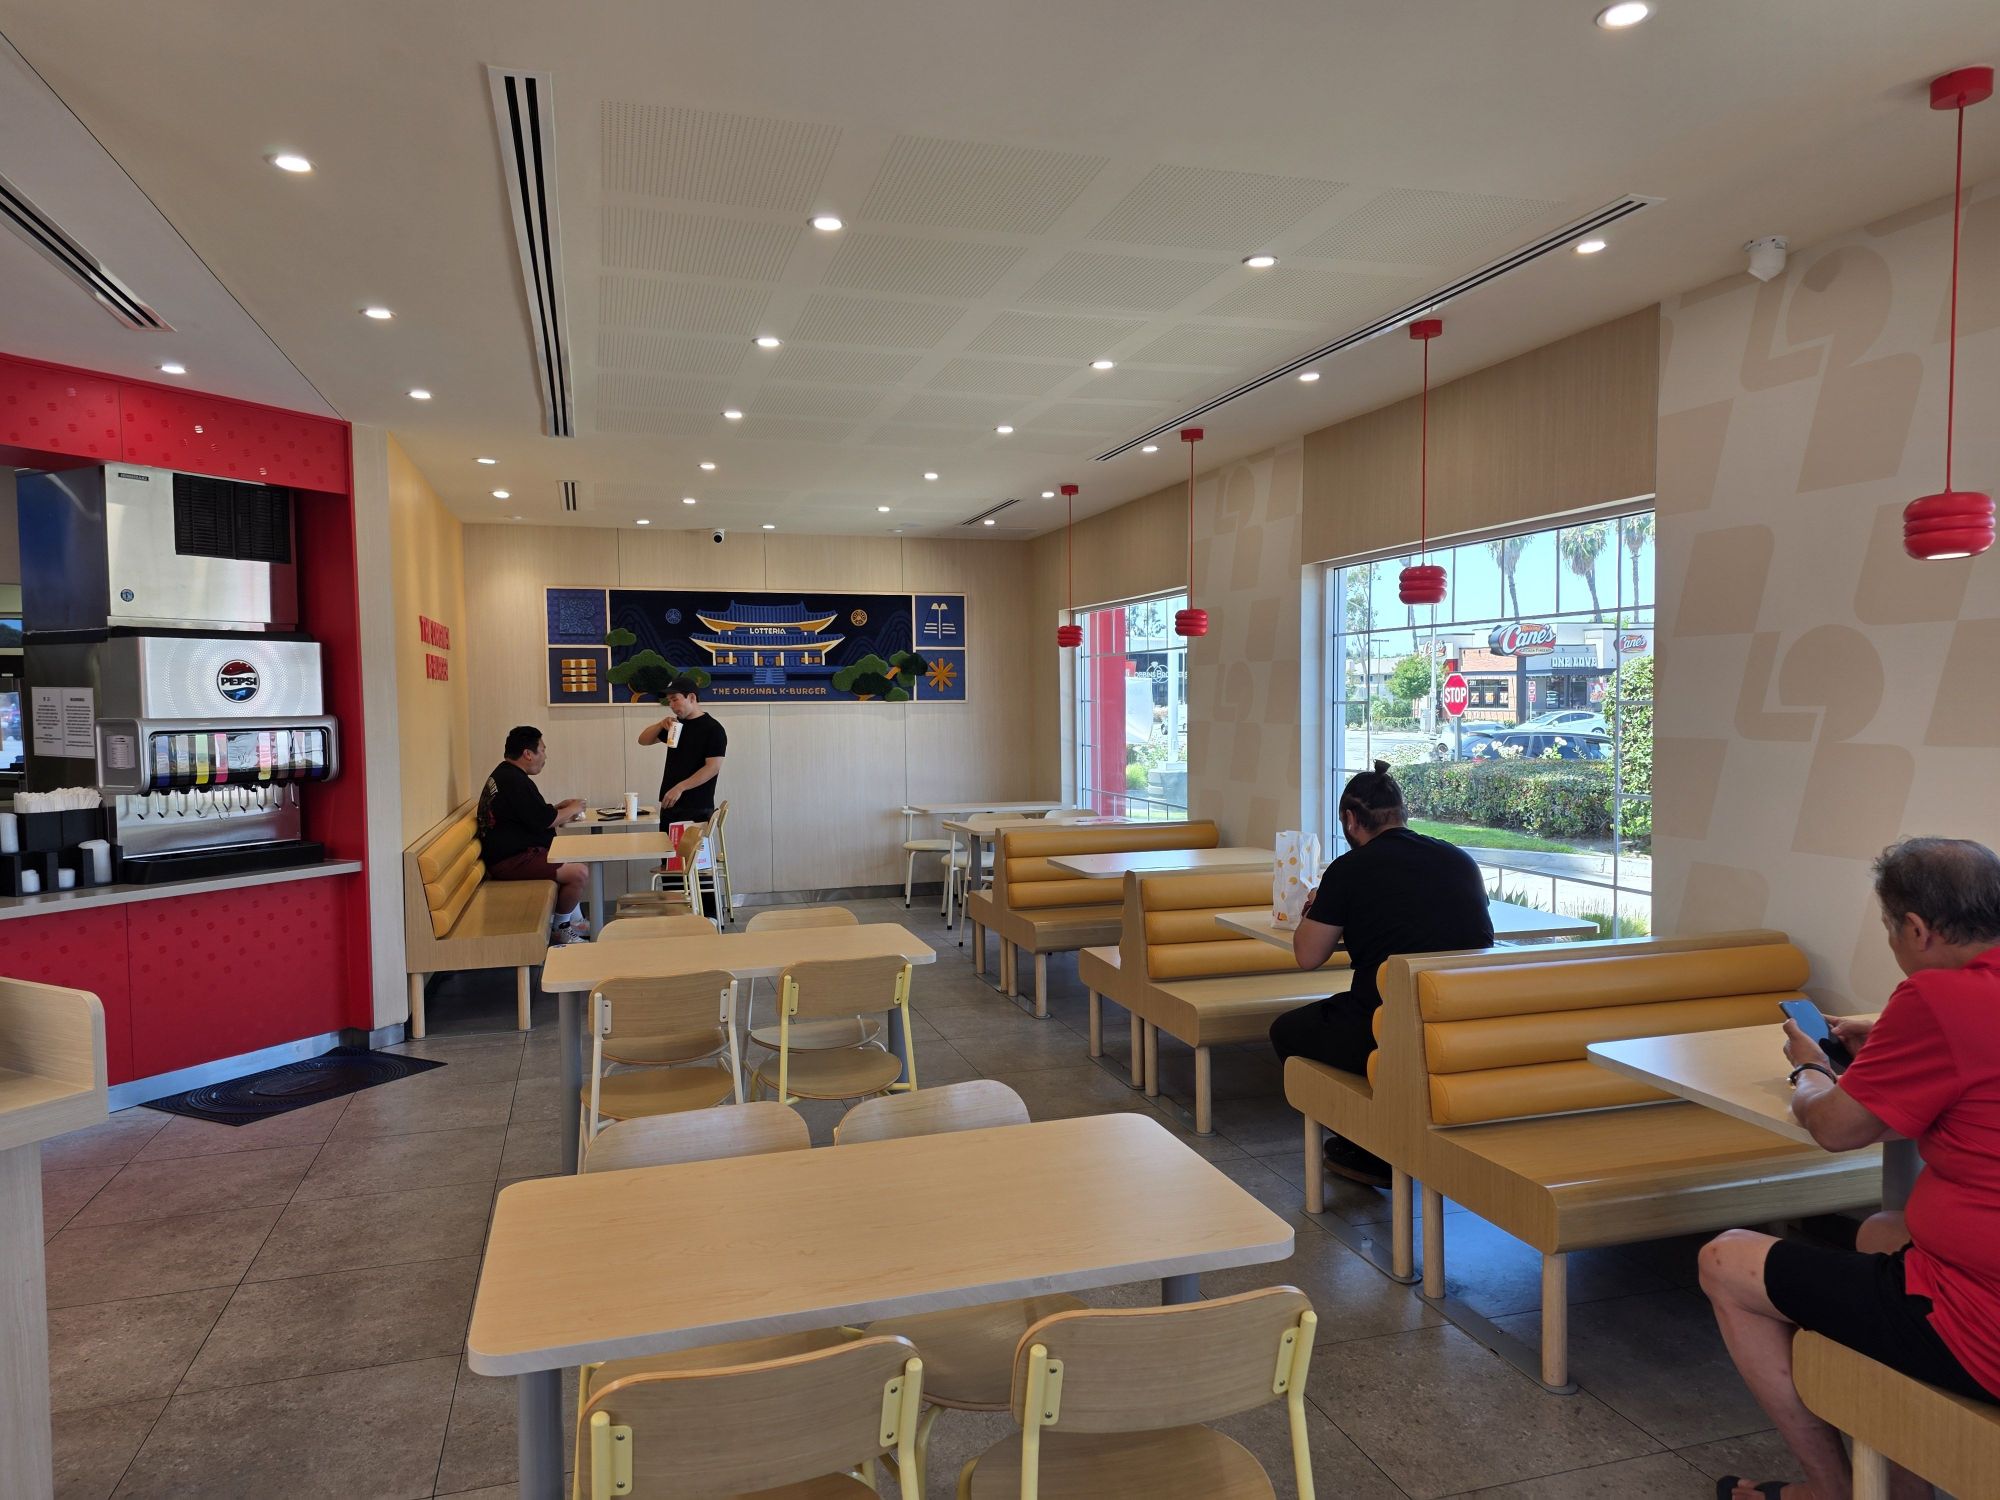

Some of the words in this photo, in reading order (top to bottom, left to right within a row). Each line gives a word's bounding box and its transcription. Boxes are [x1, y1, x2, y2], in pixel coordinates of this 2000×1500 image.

[749, 627, 786, 635] LOTTERIA
[1503, 624, 1556, 654] Cane's
[221, 677, 257, 686] PEPSI
[712, 687, 731, 695] THE
[733, 687, 777, 695] ORIGINAL
[780, 687, 826, 695] K-BURGER
[1444, 687, 1467, 704] STOP
